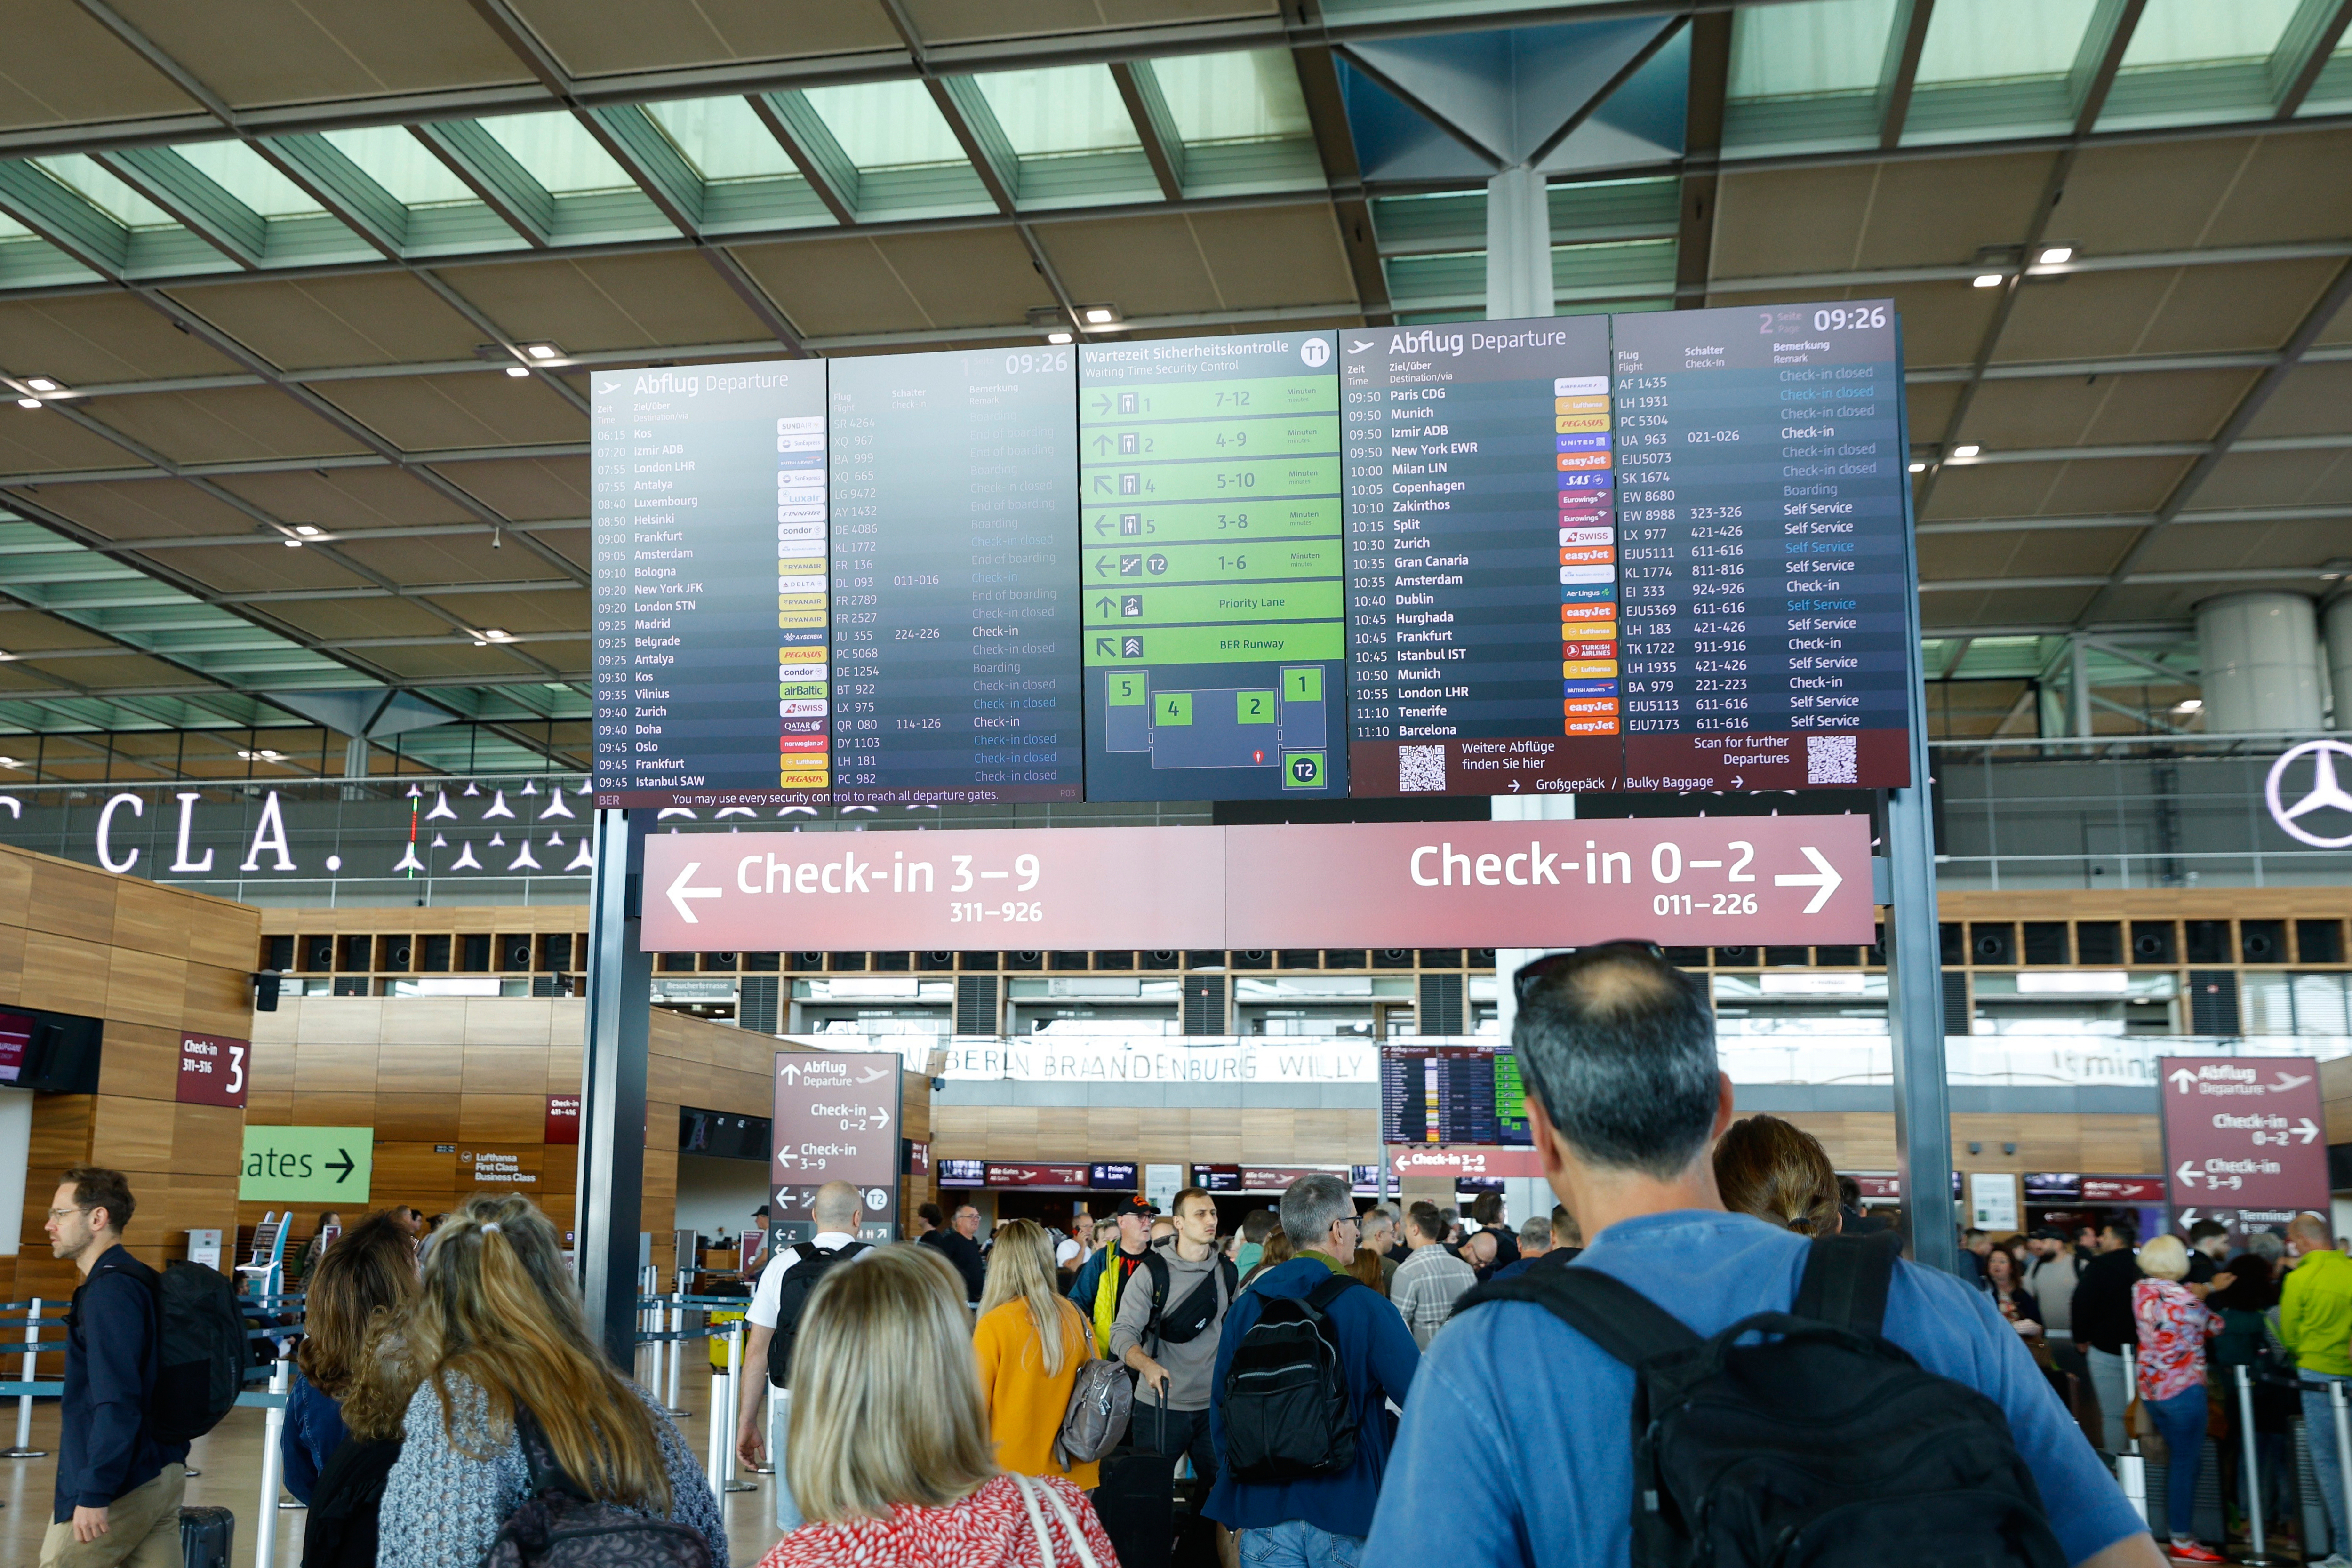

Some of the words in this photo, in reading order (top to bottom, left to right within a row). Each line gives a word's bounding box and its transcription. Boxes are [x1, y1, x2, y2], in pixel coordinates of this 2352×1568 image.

[1760, 313, 1773, 334] 2
[1814, 307, 1886, 331] 09:26
[1389, 330, 1463, 356] Abflug
[1472, 330, 1566, 353] Departure
[1086, 350, 1149, 362] Wartezeit
[1153, 340, 1289, 359] Sicherheitskontrolle
[1305, 346, 1323, 360] T1
[1006, 352, 1067, 374] 09:26
[1086, 367, 1123, 378] Waiting
[1128, 366, 1152, 375] Time
[1156, 363, 1197, 374] Security
[1201, 360, 1238, 371] Control
[634, 373, 698, 397] Abflug
[707, 374, 789, 394] Departure
[1144, 398, 1150, 411] 1
[1215, 392, 1249, 407] 7-12
[1145, 438, 1153, 452] 2
[1216, 432, 1246, 447] 4-9
[1146, 479, 1155, 492] 4
[1218, 473, 1255, 488] 5-10
[1147, 520, 1155, 533] 5
[1218, 514, 1248, 529] 3-8
[1149, 559, 1164, 570] T2
[1219, 555, 1246, 570] 1-6
[1220, 599, 1257, 609] Priority
[1221, 640, 1240, 649] BER
[1244, 640, 1284, 650] Runway
[1628, 663, 1642, 673] LH
[1648, 662, 1676, 672] 1935
[1696, 660, 1746, 671] 421-426
[1789, 658, 1811, 669] Self
[1816, 657, 1857, 668] Service
[1357, 671, 1387, 681] 10:50
[1398, 668, 1440, 680] Munich
[1122, 681, 1131, 696] 5
[1299, 676, 1305, 692] 1
[1629, 682, 1644, 692] BA
[1651, 681, 1673, 692] 979
[1696, 679, 1746, 690] 221-223
[1790, 676, 1842, 688] Check-in
[1357, 689, 1388, 699] 10:55
[1399, 688, 1441, 698] London
[1446, 687, 1468, 696] LHR
[1168, 701, 1179, 716] 4
[1251, 699, 1260, 714] 2
[1569, 702, 1614, 712] easyJet
[1630, 701, 1679, 711] EJU5113
[1696, 699, 1748, 710] 611-616
[1791, 696, 1812, 707] Self
[1816, 696, 1859, 707] Service
[1358, 708, 1388, 718] 11:10
[1399, 706, 1447, 717] Tenerife
[1570, 721, 1614, 731] easyJet
[1630, 720, 1679, 730] EJU7173
[1697, 718, 1748, 729] 611-616
[1791, 716, 1813, 727] Self
[1817, 715, 1859, 726] Service
[1358, 727, 1389, 737] 11:10
[1400, 725, 1456, 736] Barcelona
[600, 743, 627, 752] 09:45
[636, 742, 657, 752] Oslo
[1462, 743, 1505, 753] Weitere
[1510, 742, 1554, 754] Abflüge
[1695, 738, 1721, 748] Scan
[1725, 736, 1743, 747] for
[1746, 736, 1789, 747] further
[600, 760, 627, 770] 09:45
[636, 759, 684, 769] Frankfurt
[1462, 759, 1499, 769] finden
[1503, 759, 1519, 768] Sie
[1523, 758, 1545, 768] hier
[1724, 753, 1789, 767] Departures
[1295, 764, 1313, 776] T2
[600, 778, 627, 787] 09:45
[637, 776, 678, 786] Istanbul
[681, 776, 704, 786] SAW
[1536, 779, 1605, 791] Großgepäck
[1627, 777, 1659, 790] Bulky
[1663, 777, 1713, 790] Baggage
[600, 795, 619, 805] BER
[673, 795, 691, 803] You
[695, 796, 716, 806] may
[739, 795, 767, 805] every
[770, 792, 808, 804] security
[854, 792, 864, 801] to
[868, 791, 895, 801] reach
[899, 790, 910, 800] all
[914, 790, 964, 803] departure
[968, 790, 998, 801] gates.
[1411, 840, 1631, 886] Check-in
[738, 851, 933, 893] Check-in
[184, 1040, 217, 1055] Check-in
[226, 1046, 243, 1093] 3
[803, 1061, 846, 1076] Abflug
[944, 1050, 1028, 1077] BERLN
[2198, 1065, 2256, 1084] Abflug
[804, 1076, 852, 1088] Departure
[2199, 1082, 2265, 1096] Departure
[811, 1104, 866, 1116] Check-in
[2213, 1113, 2288, 1128] Check-in
[801, 1143, 856, 1155] Check-in
[239, 1147, 312, 1178] ates
[476, 1153, 517, 1162] Lufthansa
[922, 1145, 928, 1168] 4
[1412, 1153, 1460, 1165] Check-in
[495, 1163, 518, 1171] Class
[1108, 1166, 1132, 1174] Priority
[2205, 1159, 2280, 1173] Check-in
[475, 1173, 512, 1181] Business
[512, 1173, 536, 1182] Class
[870, 1194, 883, 1204] T2
[2237, 1210, 2296, 1224] Terminal
